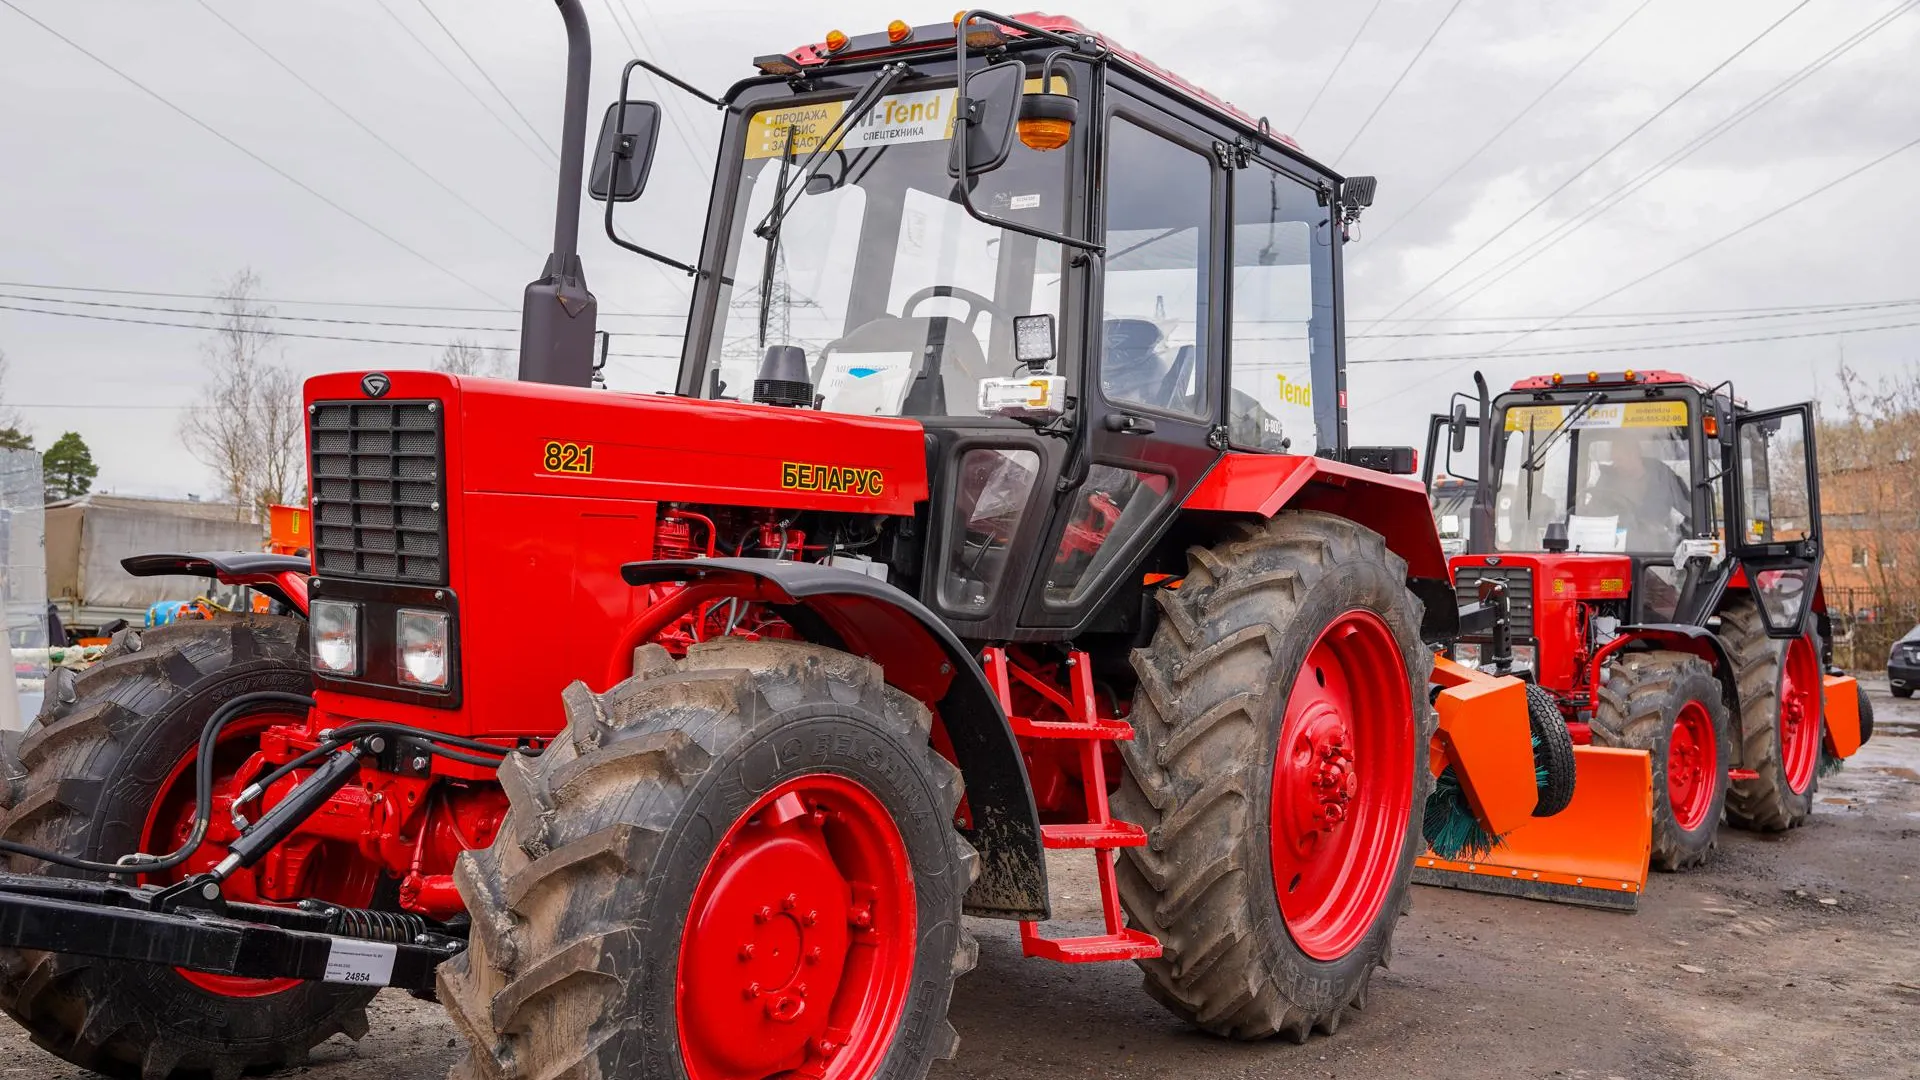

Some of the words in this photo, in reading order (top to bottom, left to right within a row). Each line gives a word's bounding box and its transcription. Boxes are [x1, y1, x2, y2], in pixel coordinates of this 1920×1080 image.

[775, 109, 828, 126] ПРОДАЖА
[863, 126, 924, 141] СПЕЦТЕХНИКА
[1276, 373, 1311, 408] Tend
[544, 441, 593, 474] 82.1
[782, 462, 884, 496] БЕЛАРУС
[344, 971, 371, 982] 24854
